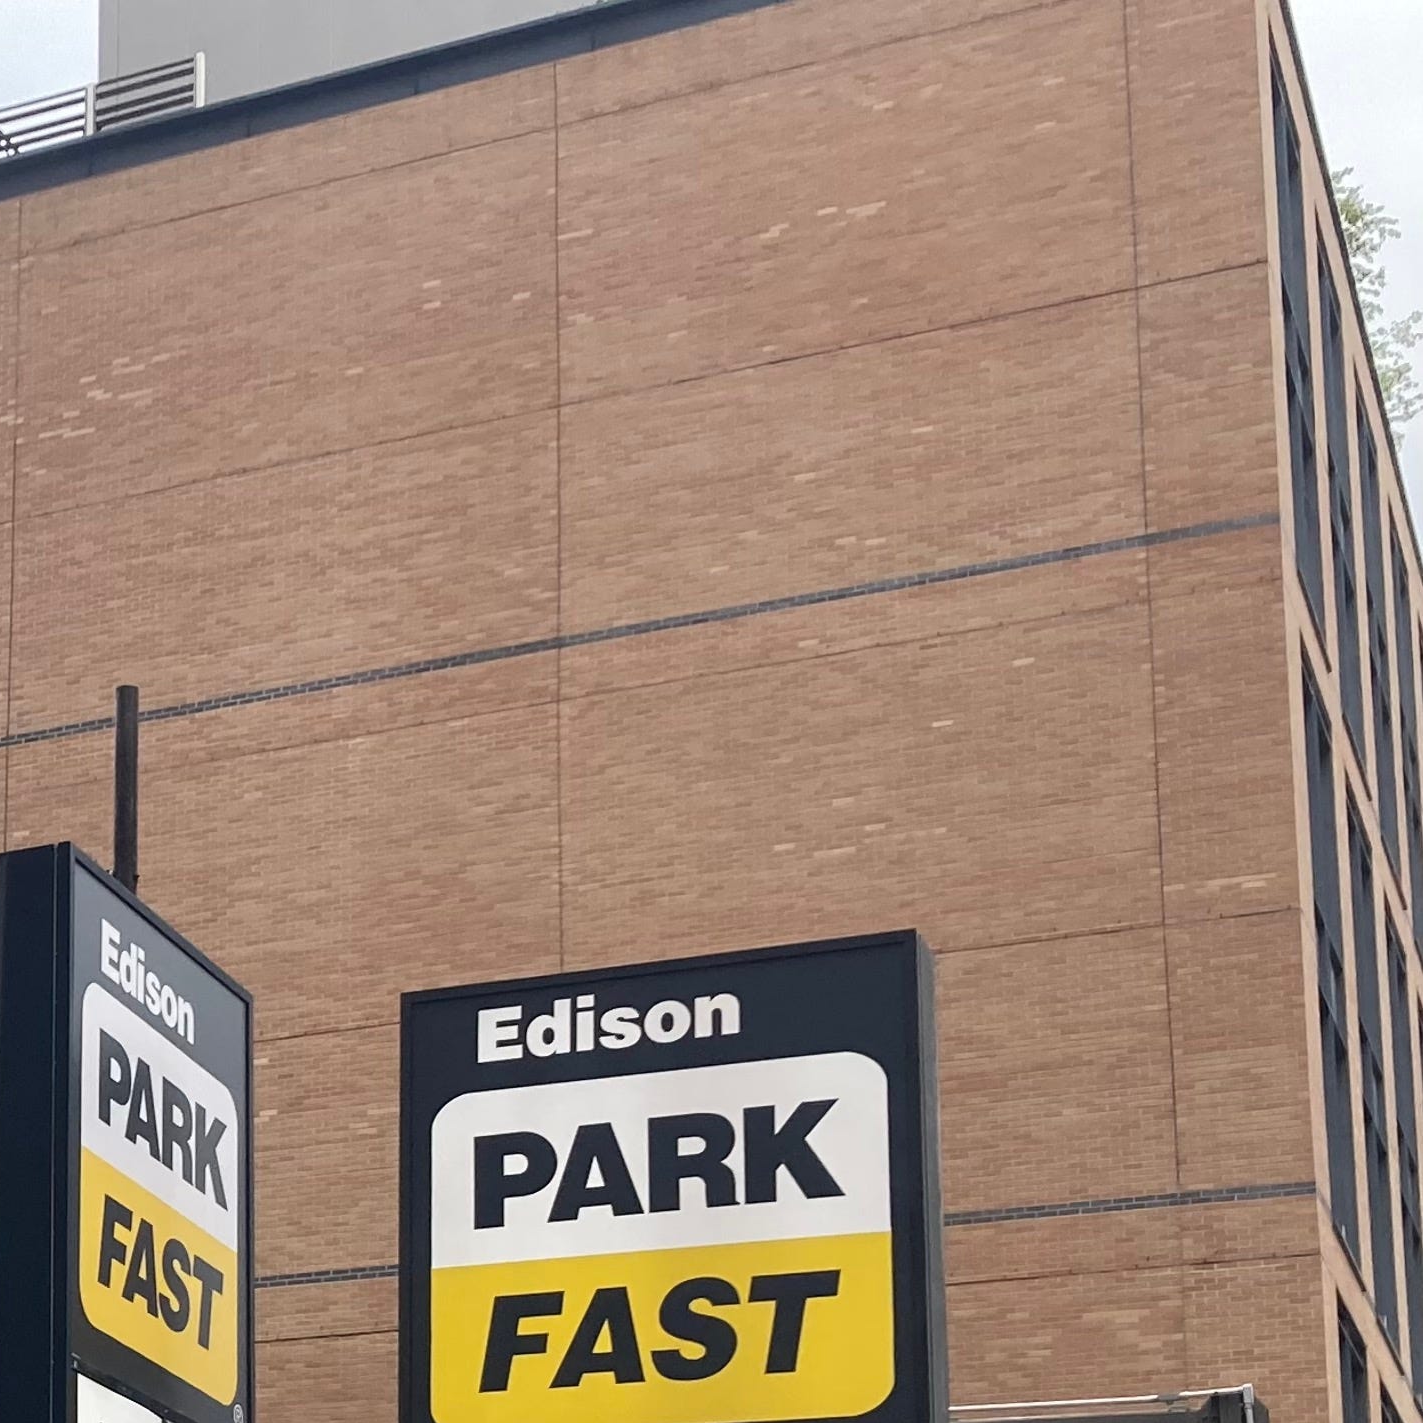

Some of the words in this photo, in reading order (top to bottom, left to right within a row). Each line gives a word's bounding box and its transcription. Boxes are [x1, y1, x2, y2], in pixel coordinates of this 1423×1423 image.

[101, 918, 195, 1045] Edison
[477, 993, 741, 1063] Edison
[99, 1028, 228, 1212] PARK
[474, 1098, 846, 1230] PARK
[98, 1194, 224, 1350] FAST
[479, 1269, 841, 1393] FAST
